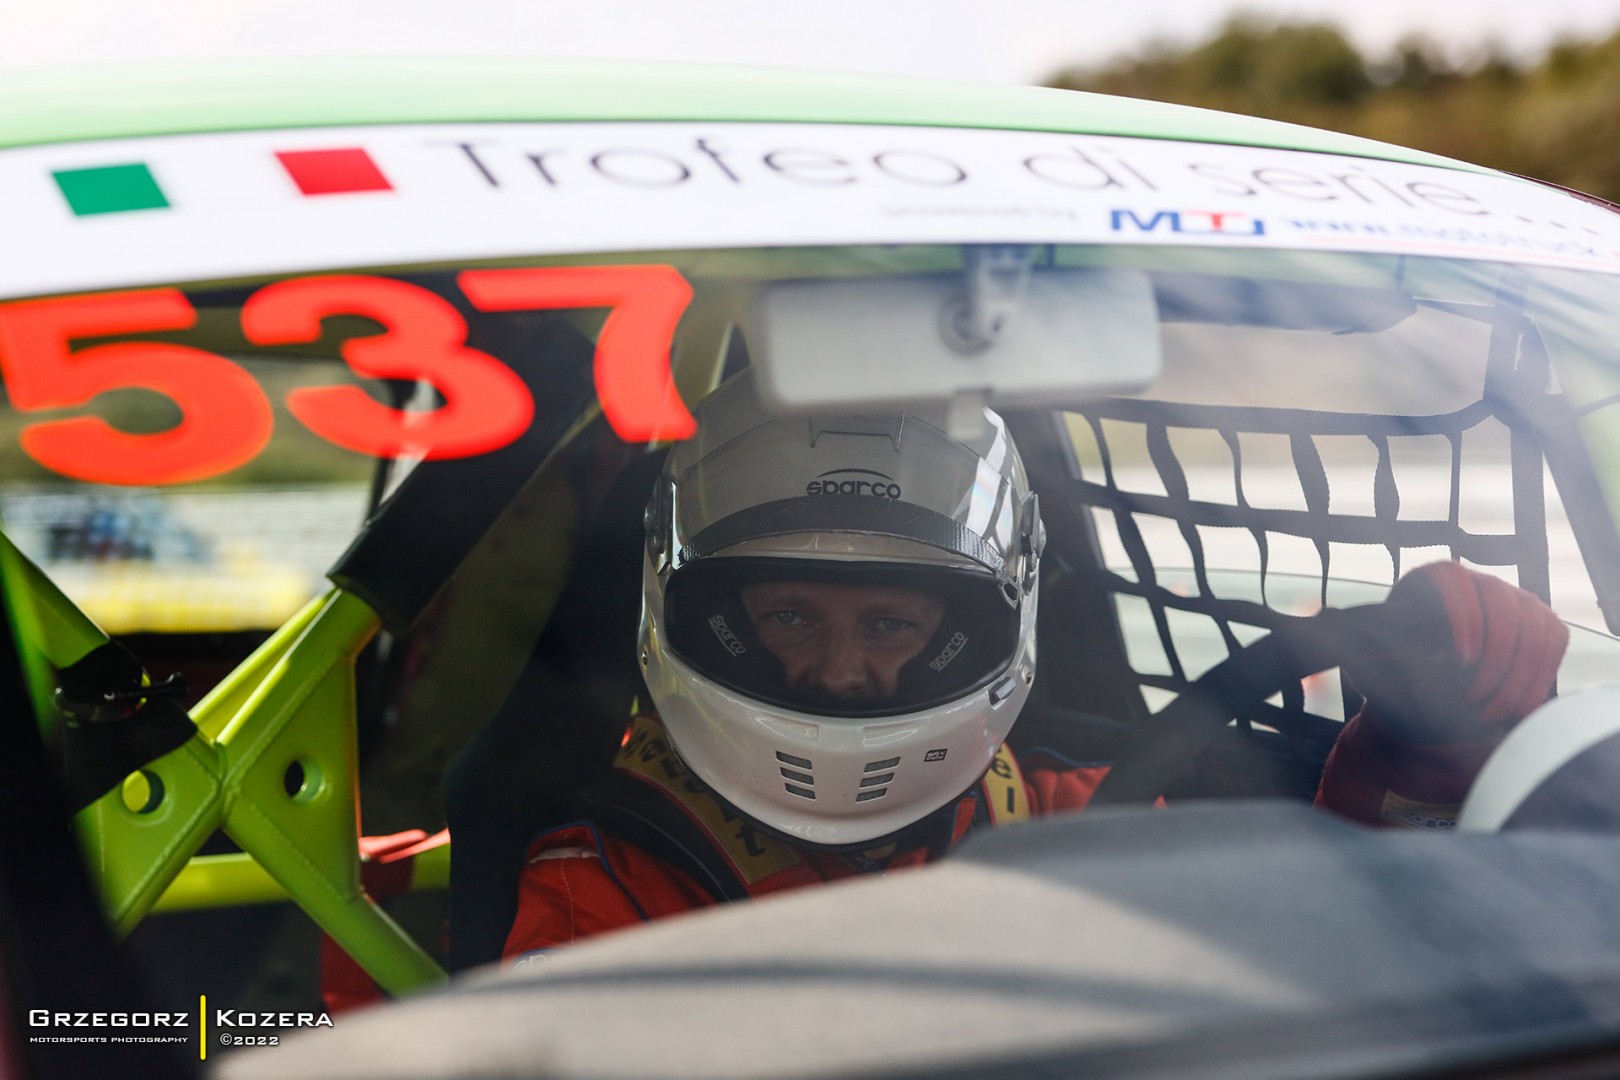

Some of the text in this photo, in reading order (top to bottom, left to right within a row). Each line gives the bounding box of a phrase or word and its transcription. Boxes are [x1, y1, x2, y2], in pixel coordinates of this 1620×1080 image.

[420, 136, 969, 190] Trofeo
[1022, 145, 1159, 193] di
[0, 264, 698, 487] 537
[806, 480, 902, 499] sparco
[711, 614, 747, 654] sparco
[928, 631, 965, 670] sparco
